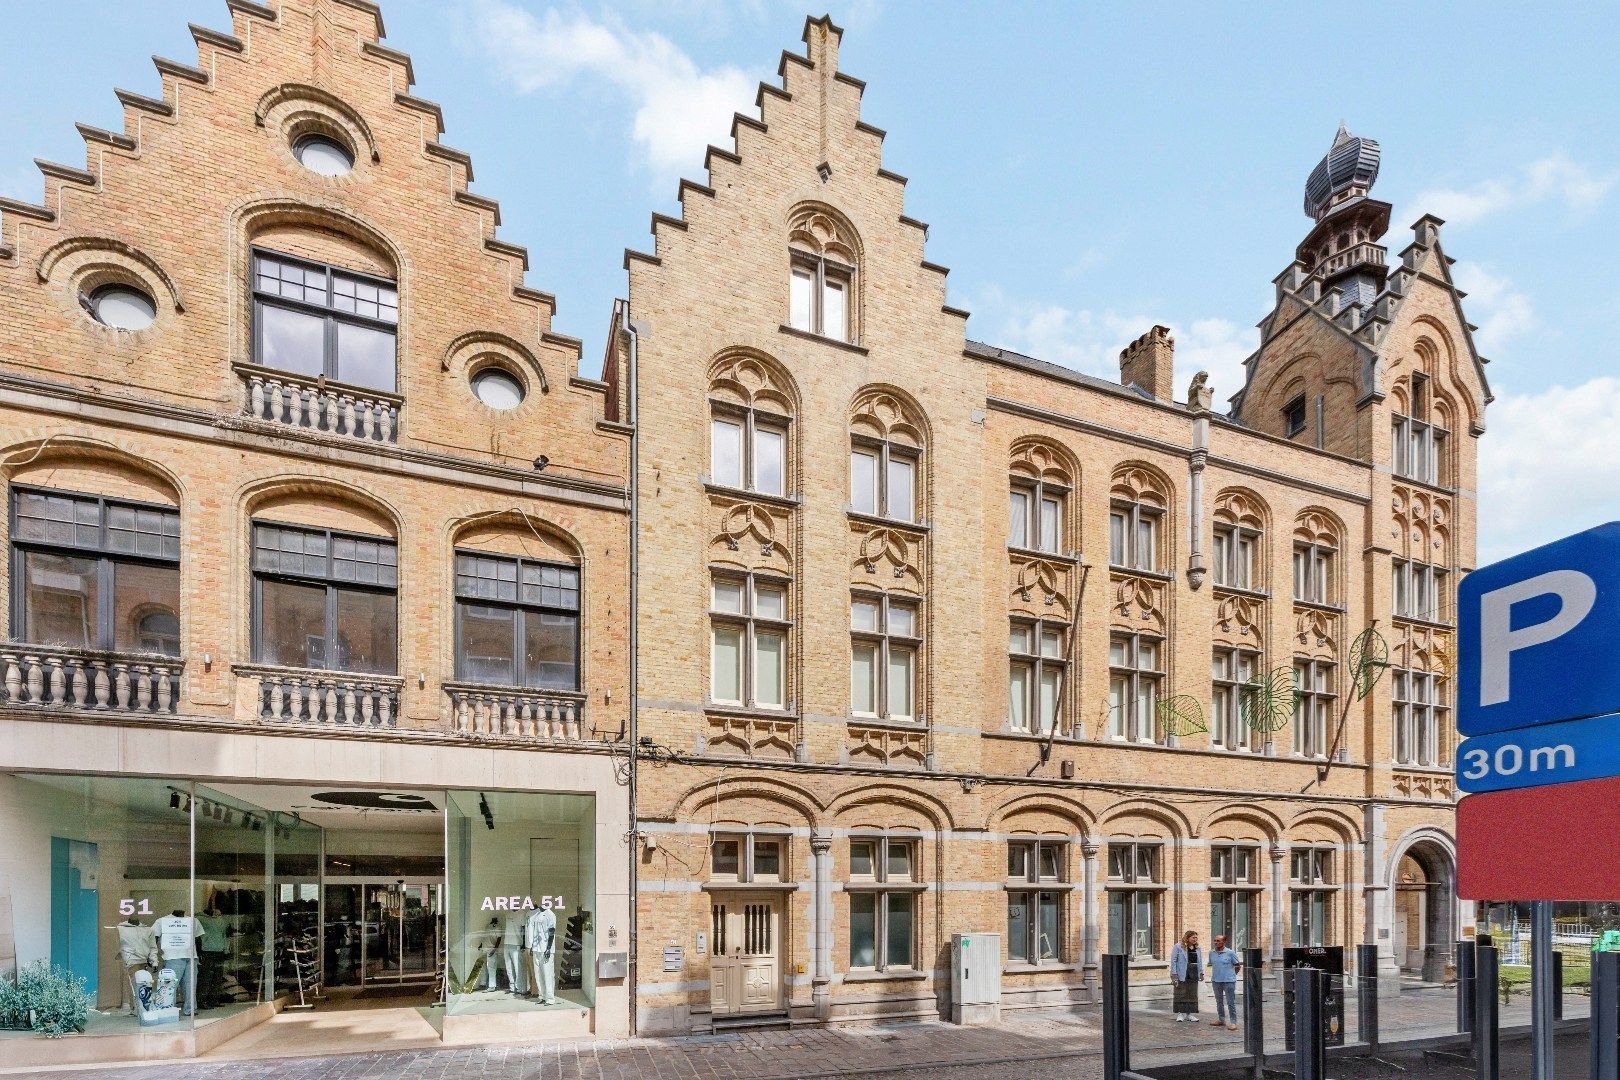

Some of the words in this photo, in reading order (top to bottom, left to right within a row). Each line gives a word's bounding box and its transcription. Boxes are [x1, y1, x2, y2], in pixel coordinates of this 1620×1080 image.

[1480, 569, 1597, 707] P
[1462, 744, 1576, 780] 30m
[119, 898, 154, 916] 51
[480, 896, 535, 911] AREA
[541, 895, 566, 910] 51
